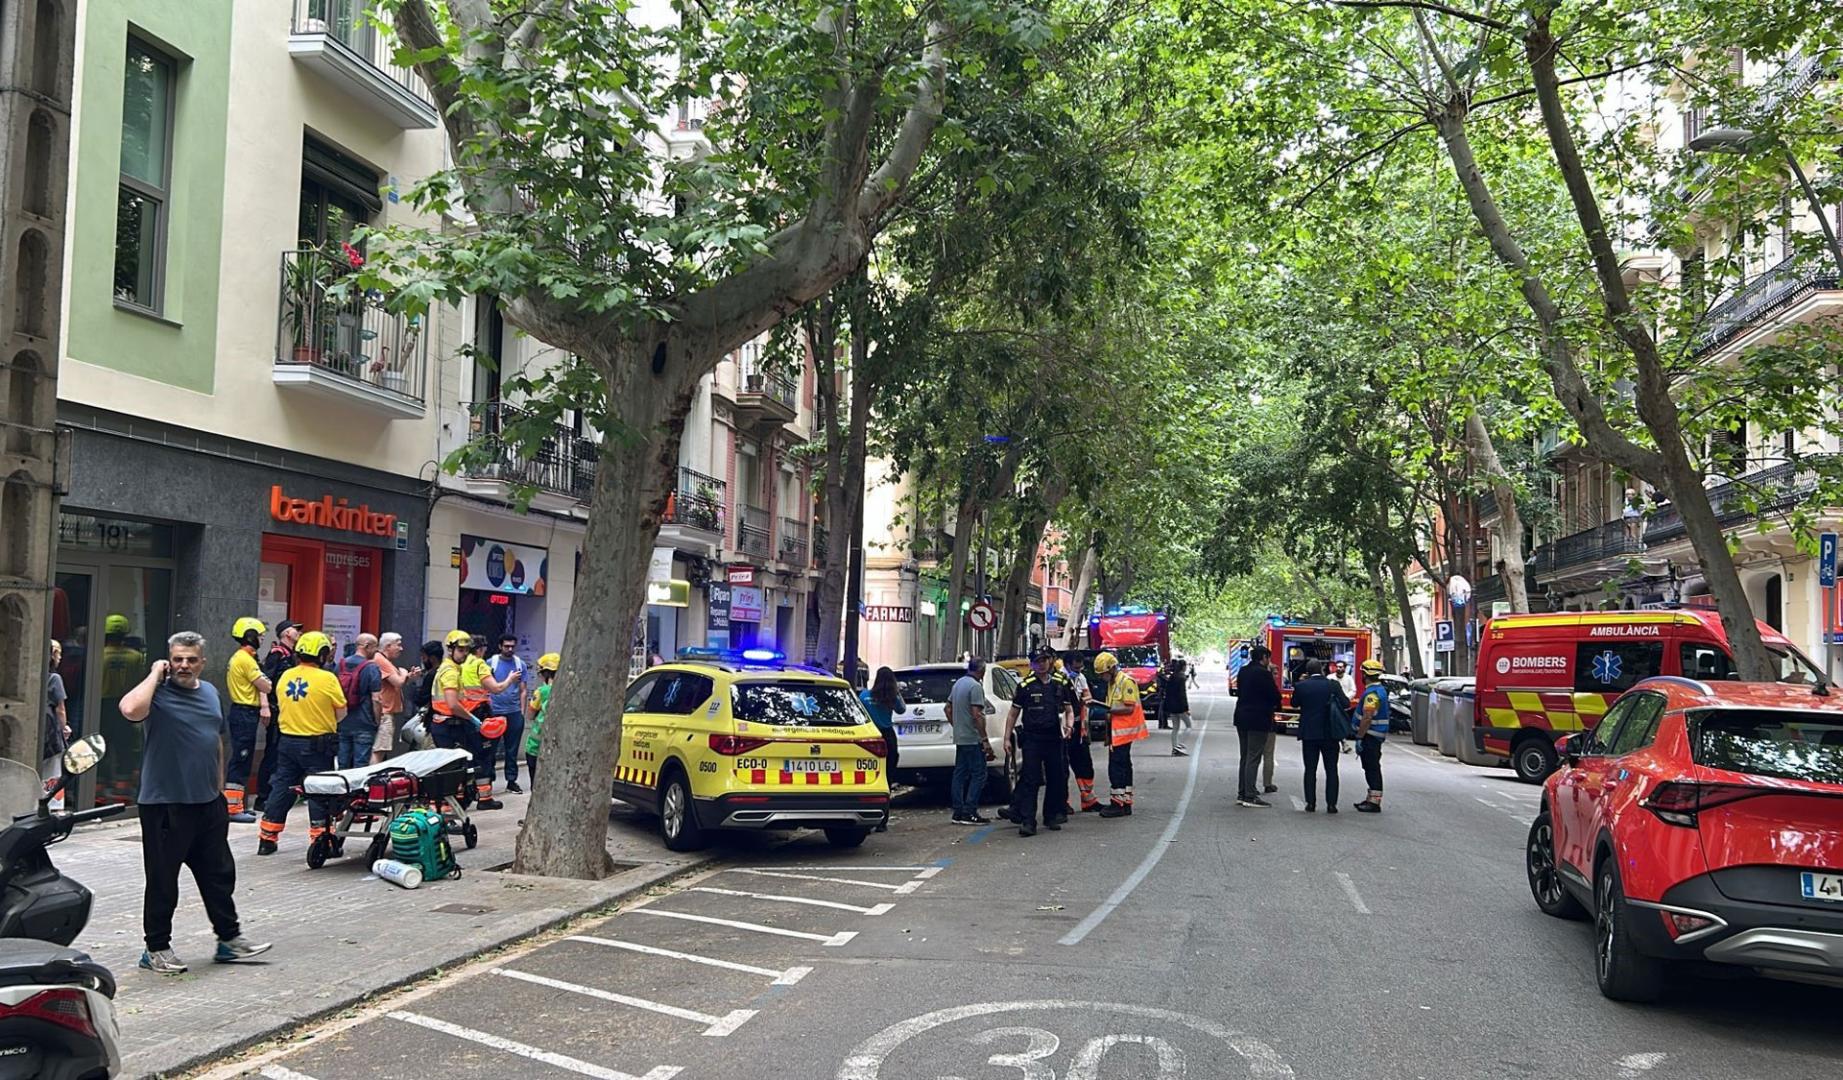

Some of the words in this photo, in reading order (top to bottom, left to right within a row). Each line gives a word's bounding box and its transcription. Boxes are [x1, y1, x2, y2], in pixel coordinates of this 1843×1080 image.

[98, 523, 129, 550] 181
[1823, 541, 1833, 560] P
[325, 551, 370, 568] mpreses
[1438, 623, 1450, 640] P
[1590, 625, 1660, 637] AMBULÀNCIA
[1512, 656, 1567, 668] BOMBERS
[699, 761, 717, 773] 0500
[737, 758, 768, 769] ECO-0
[791, 761, 816, 771] 1410
[818, 762, 837, 771] LGJ
[856, 759, 878, 770] 0500
[0, 1047, 27, 1056] YMCO
